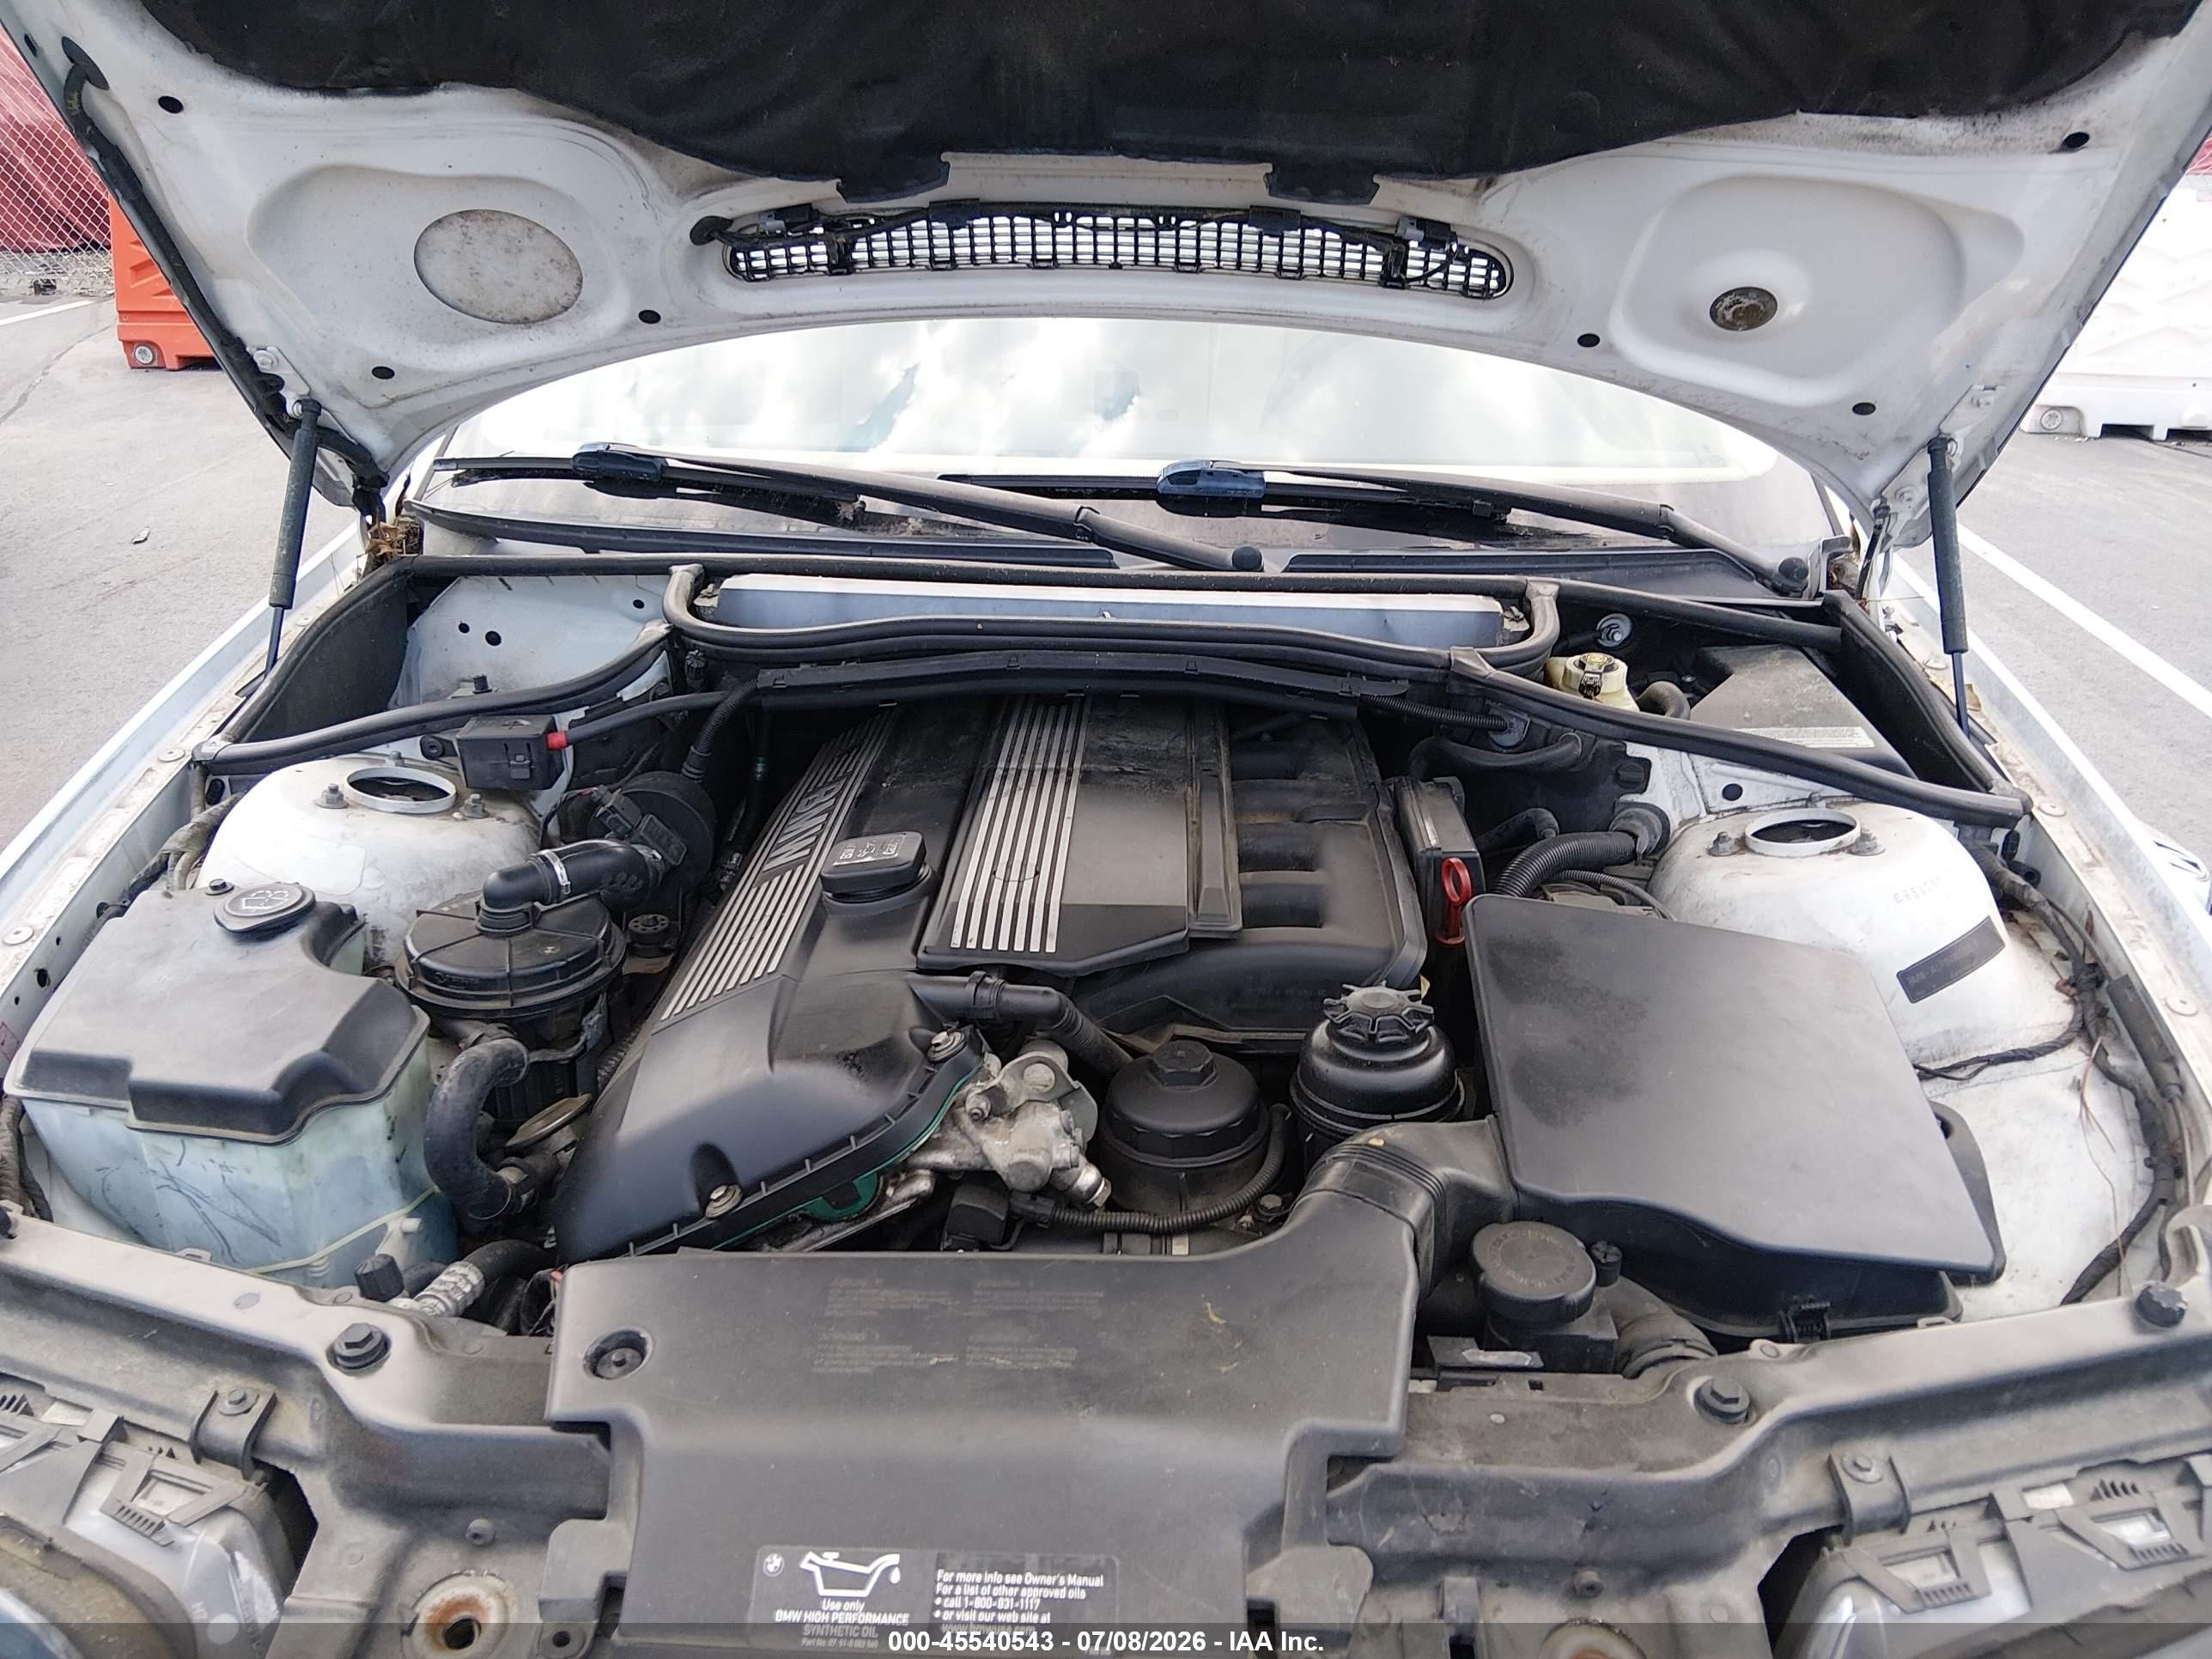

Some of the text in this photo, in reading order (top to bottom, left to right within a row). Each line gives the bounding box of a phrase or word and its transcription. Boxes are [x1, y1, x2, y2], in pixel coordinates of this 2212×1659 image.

[762, 775, 848, 873] BMW
[936, 1569, 1104, 1588] For more info see Owner's Manual
[935, 1582, 1087, 1600] For a list of other approved oils
[822, 1598, 866, 1613] Use only
[943, 1596, 961, 1608] call
[775, 1608, 910, 1626] BMW HIGH PERFORMANCE
[942, 1610, 1051, 1624] or visit our web site at
[803, 1624, 879, 1639] SYNTHETIC OIL
